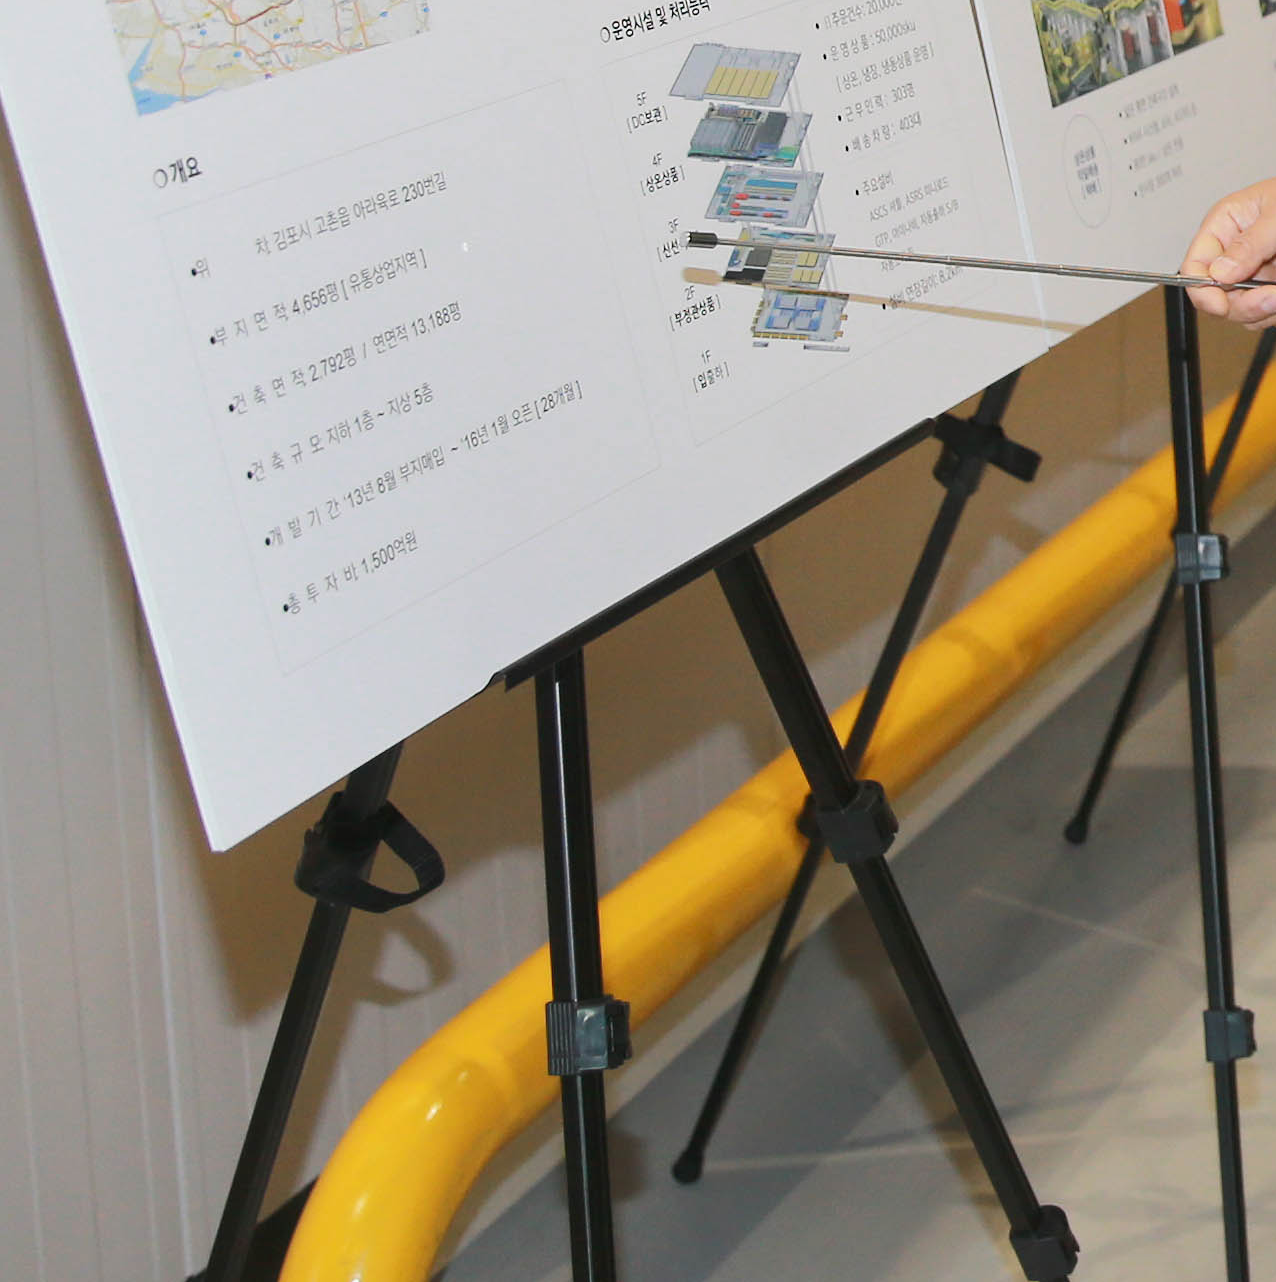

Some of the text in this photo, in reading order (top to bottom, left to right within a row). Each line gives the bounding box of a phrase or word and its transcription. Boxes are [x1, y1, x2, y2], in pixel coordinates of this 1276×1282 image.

[611, 9, 655, 41] 운영시설
[654, 5, 668, 27] 및
[636, 91, 647, 106] 5F
[169, 156, 202, 184] 개요
[651, 152, 662, 167] 4F
[273, 220, 313, 252] 김포시
[314, 205, 351, 233] 고촌읍
[352, 188, 400, 220] 아라육로
[400, 171, 447, 204] 230번길
[667, 218, 679, 234] 3F
[291, 280, 340, 317] 4,656평
[349, 250, 419, 295] 유통상업지역
[684, 285, 696, 301] 2F
[308, 345, 357, 384] 2,792평
[372, 323, 410, 355] 연면적
[410, 301, 463, 339] 13,188평
[701, 349, 711, 365] 1F
[399, 445, 446, 483] 부지매입
[360, 529, 419, 575] 1,500억원
